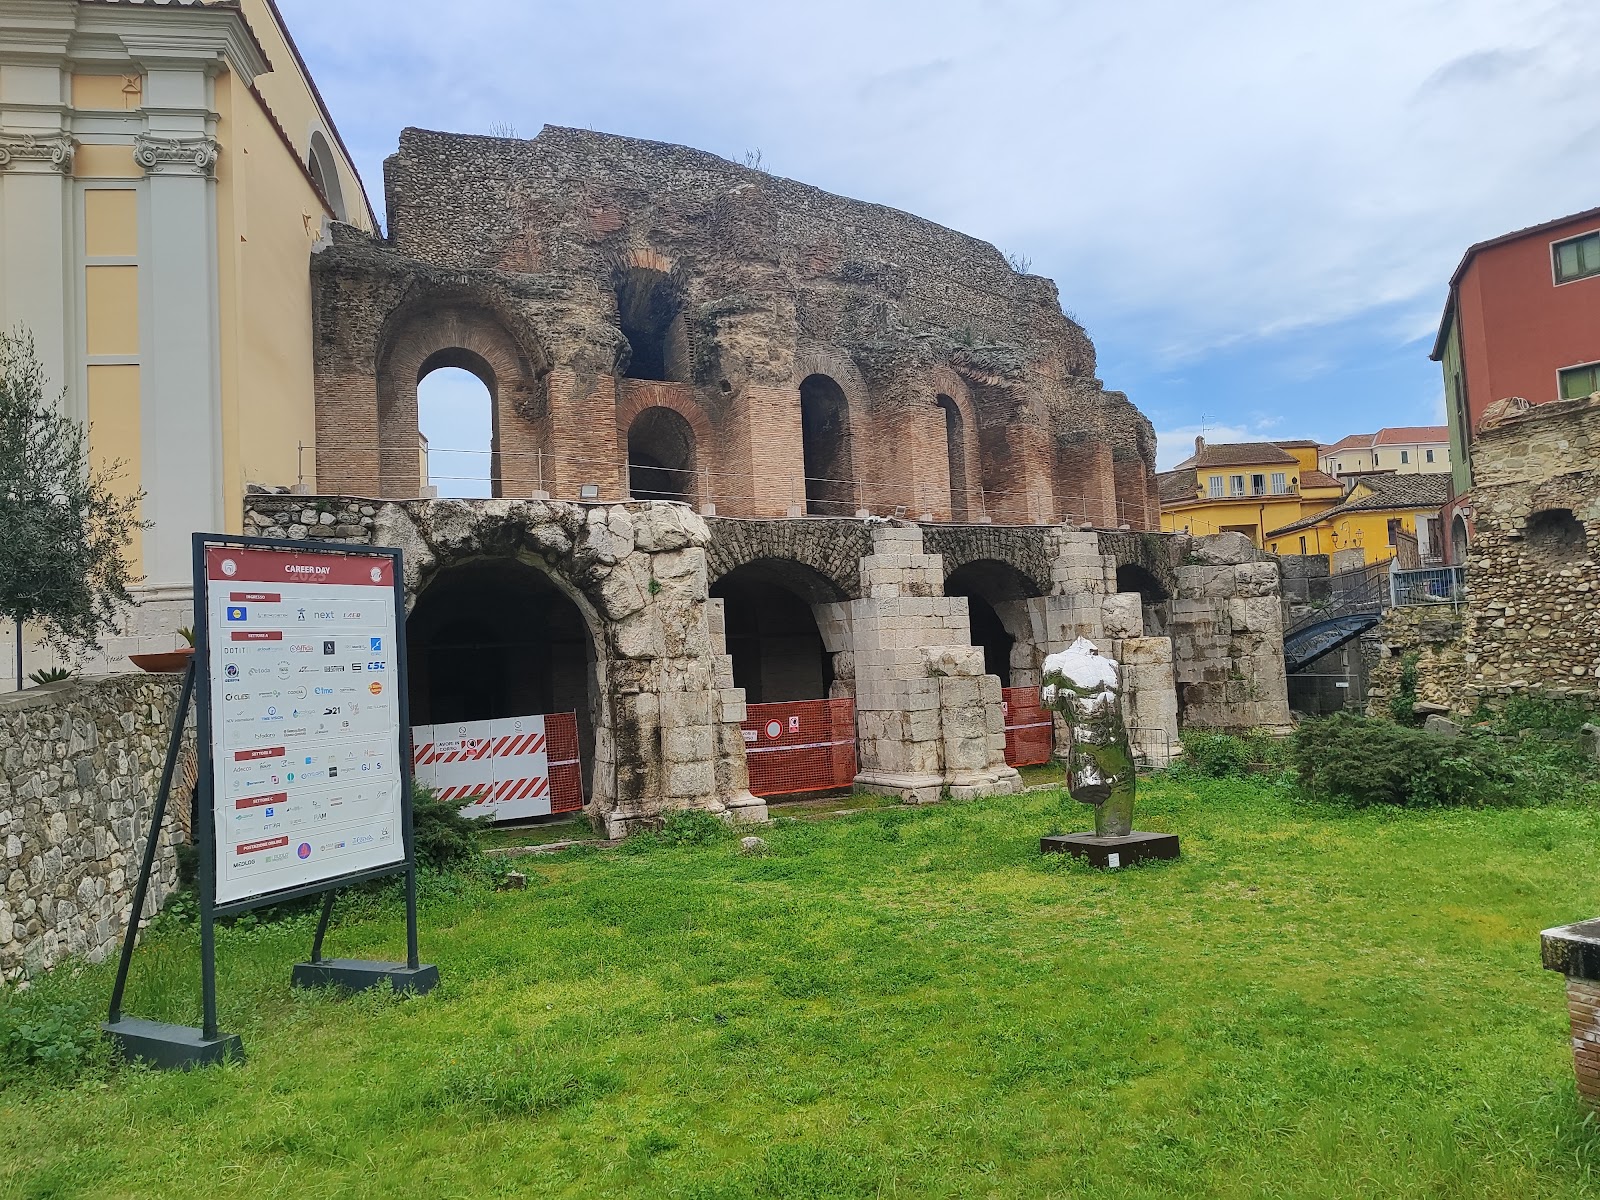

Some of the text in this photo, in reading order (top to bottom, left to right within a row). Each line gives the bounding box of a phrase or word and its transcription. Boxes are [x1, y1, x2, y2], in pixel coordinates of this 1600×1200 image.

[285, 565, 331, 574] CAREER DAY
[314, 610, 335, 619] next
